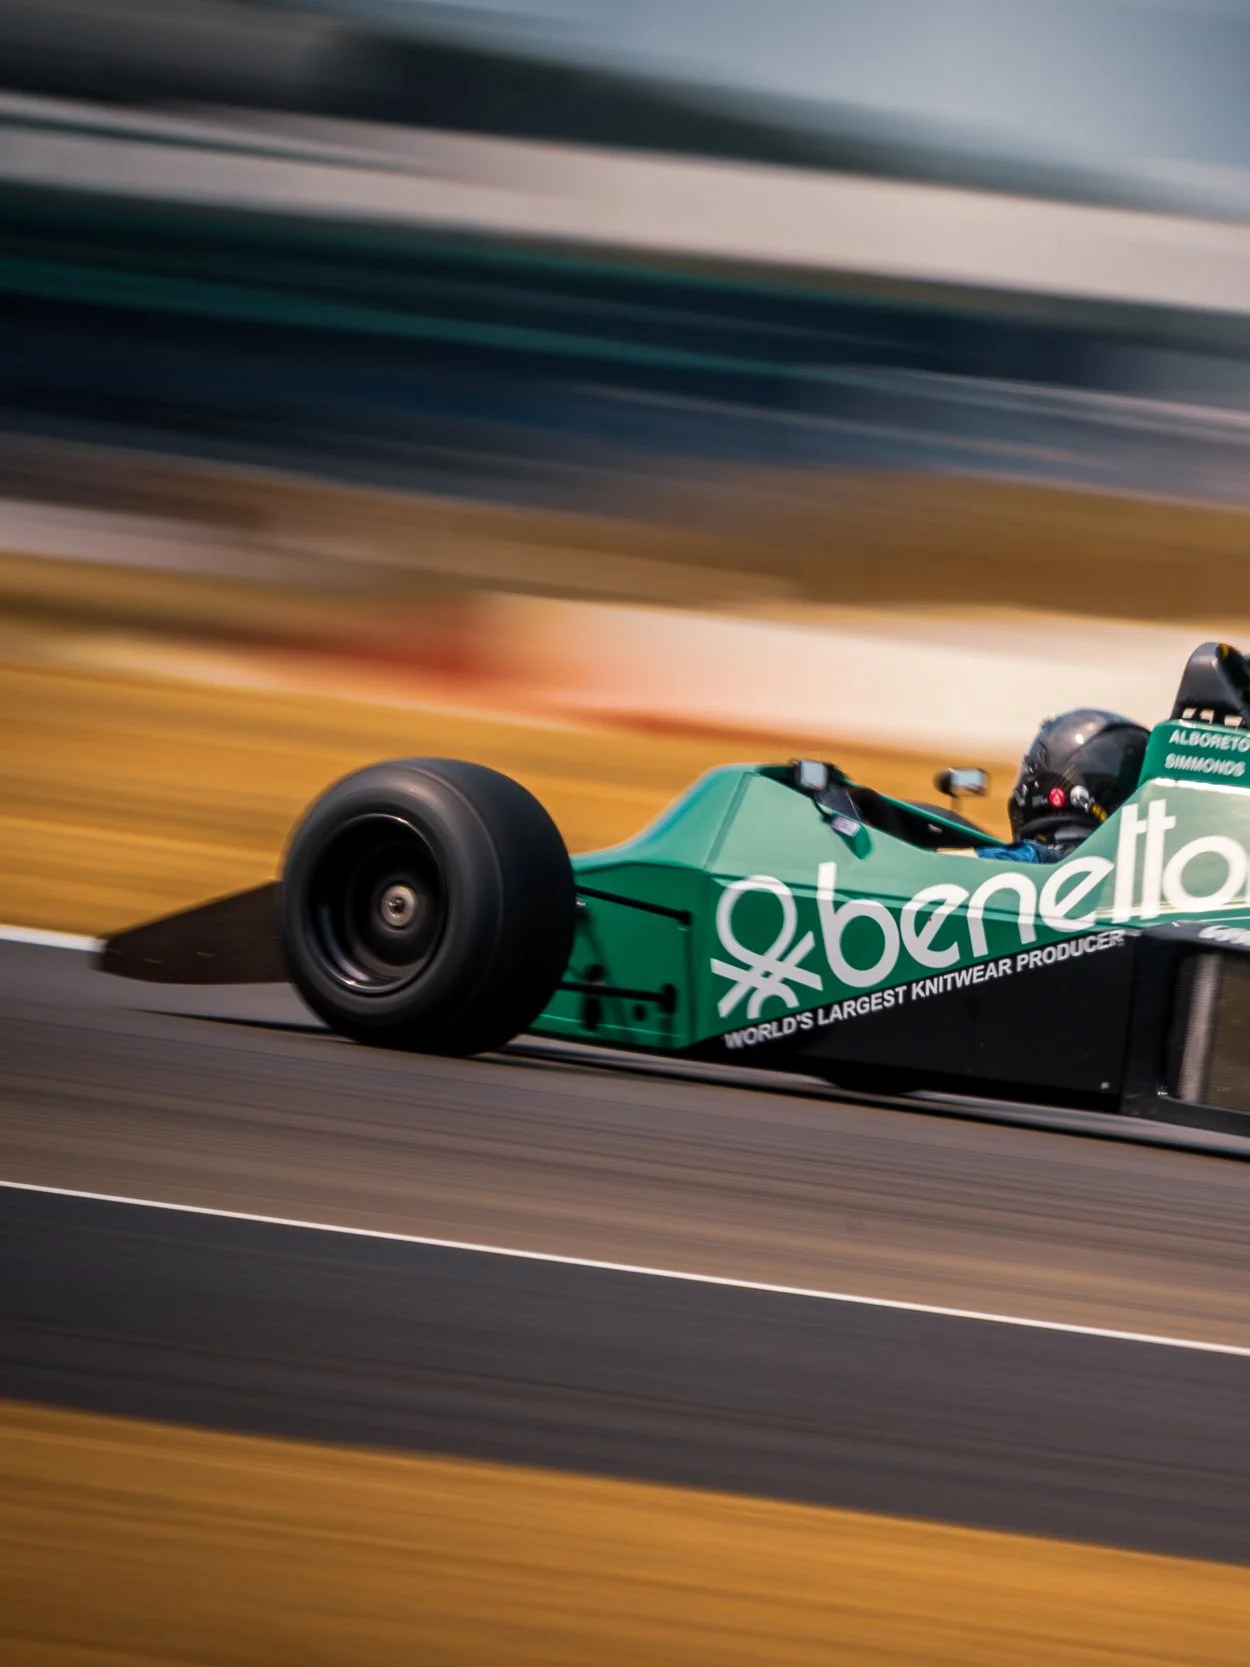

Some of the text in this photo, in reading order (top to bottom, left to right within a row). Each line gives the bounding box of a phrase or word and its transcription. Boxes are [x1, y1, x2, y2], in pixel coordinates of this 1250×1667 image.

[1164, 753, 1246, 777] SIMMONDS
[724, 929, 1126, 1049] WORLD'S LARGEST KNITWEAR PRODUCER
